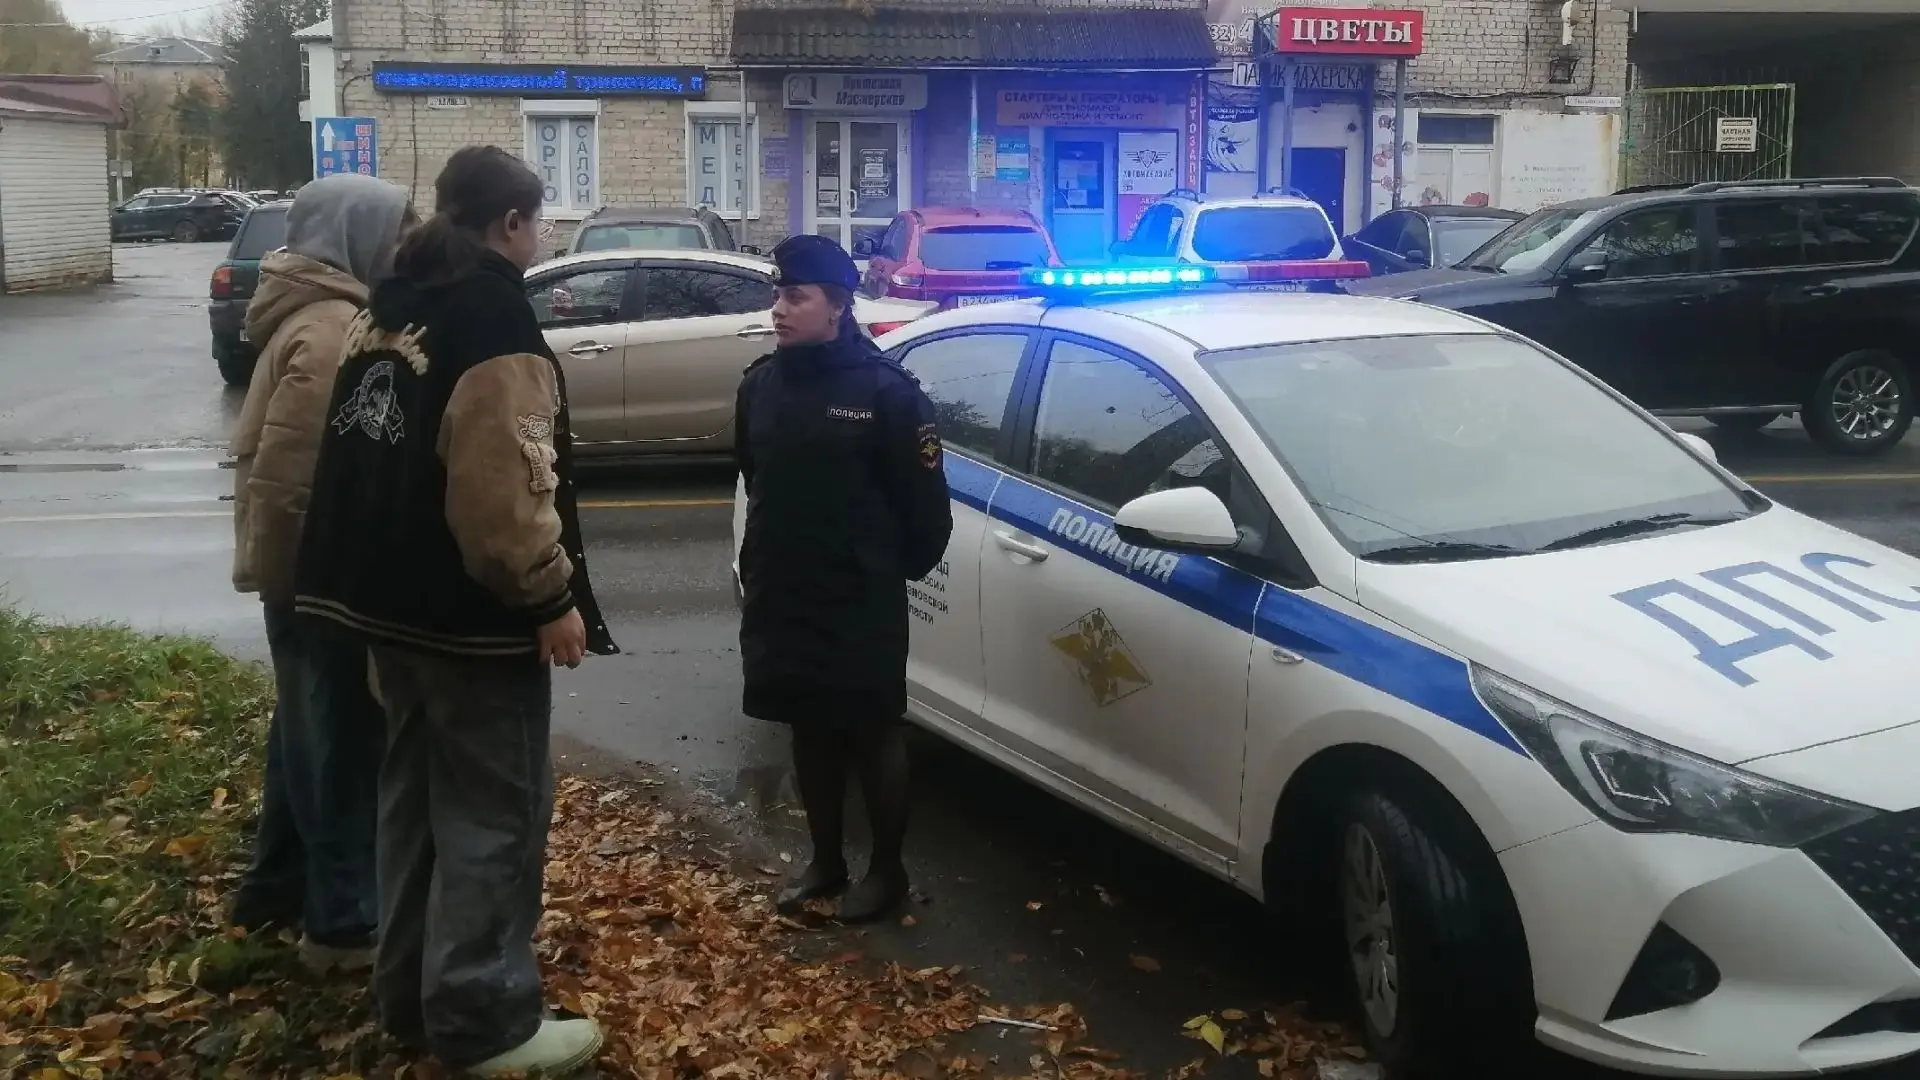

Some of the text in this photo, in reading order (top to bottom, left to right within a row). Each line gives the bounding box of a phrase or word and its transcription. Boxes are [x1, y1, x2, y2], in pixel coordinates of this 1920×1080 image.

[1291, 18, 1415, 45] ЦВЕТЫ
[541, 124, 558, 202] ОРТО
[575, 125, 590, 203] САЛОН
[700, 126, 716, 207] МЕД
[829, 408, 872, 420] ПОЛИЦИЯ
[1048, 508, 1180, 584] ПОЛИЦИЯ
[1610, 552, 1920, 687] ДПС
